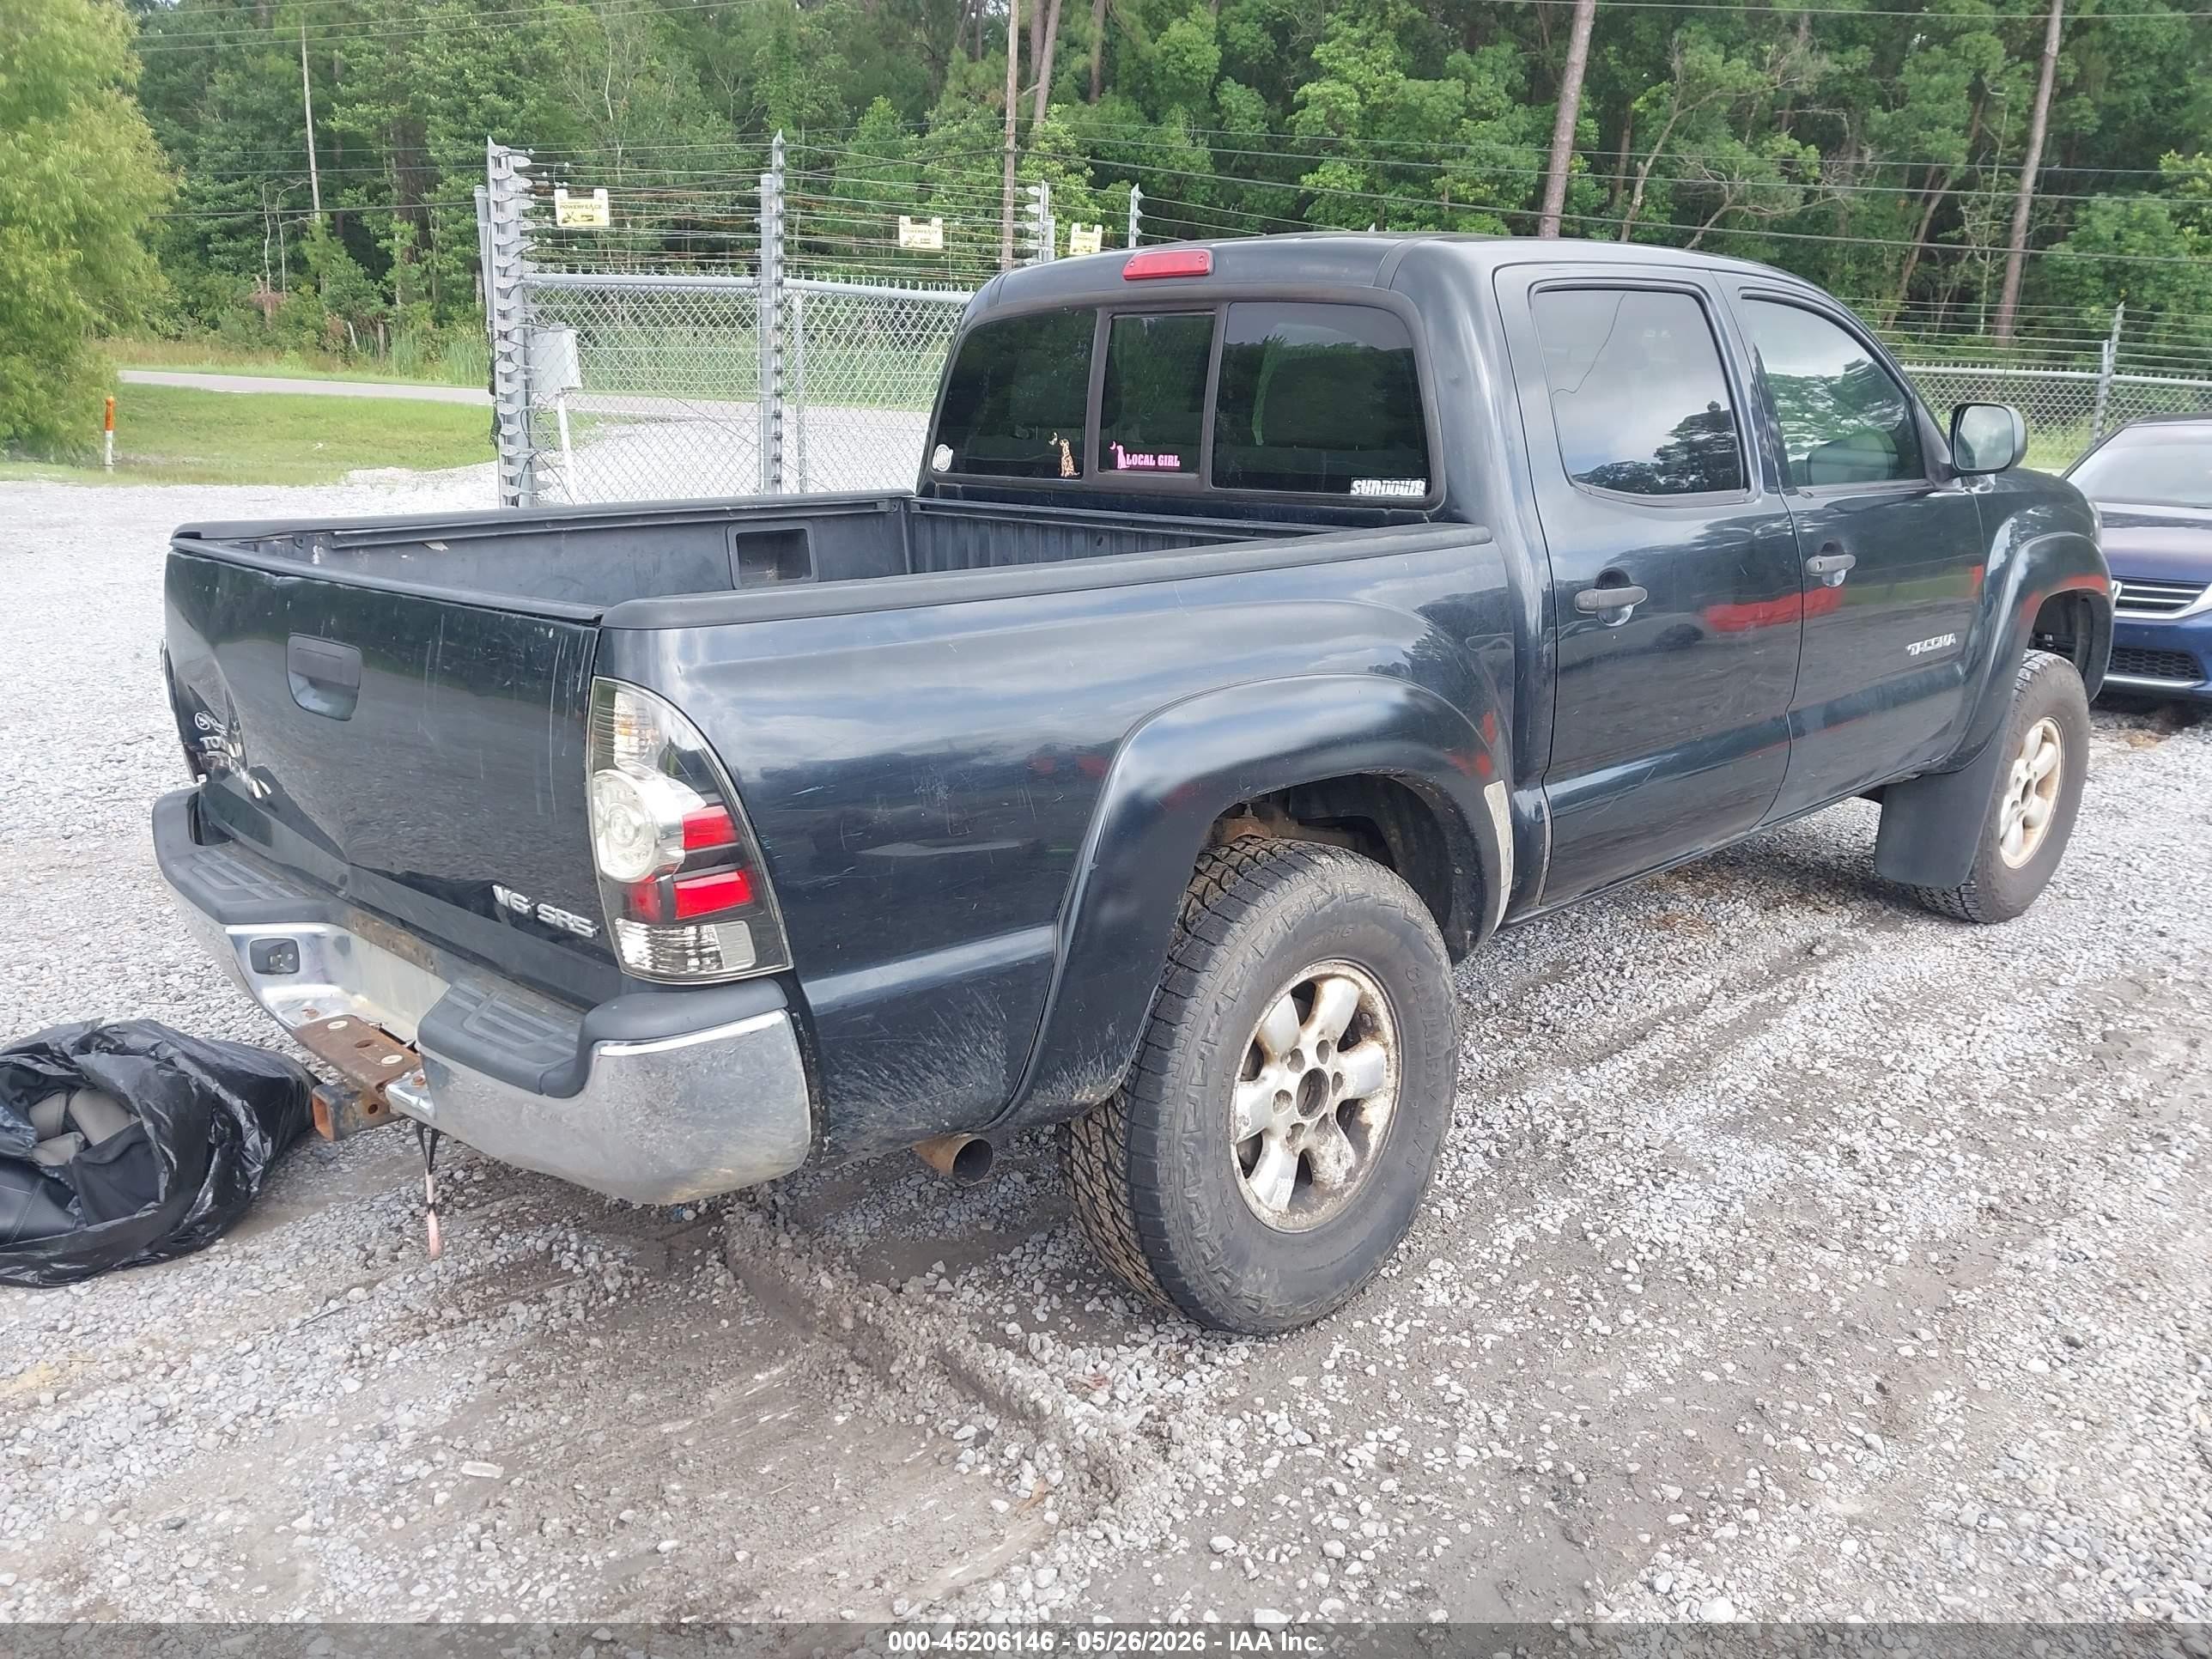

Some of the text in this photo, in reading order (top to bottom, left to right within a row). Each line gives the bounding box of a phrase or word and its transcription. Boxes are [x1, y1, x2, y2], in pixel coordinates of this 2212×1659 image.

[1126, 453, 1181, 467] LOCAL GIRL
[1905, 633, 1957, 656] TACOMA
[492, 884, 532, 915] V6
